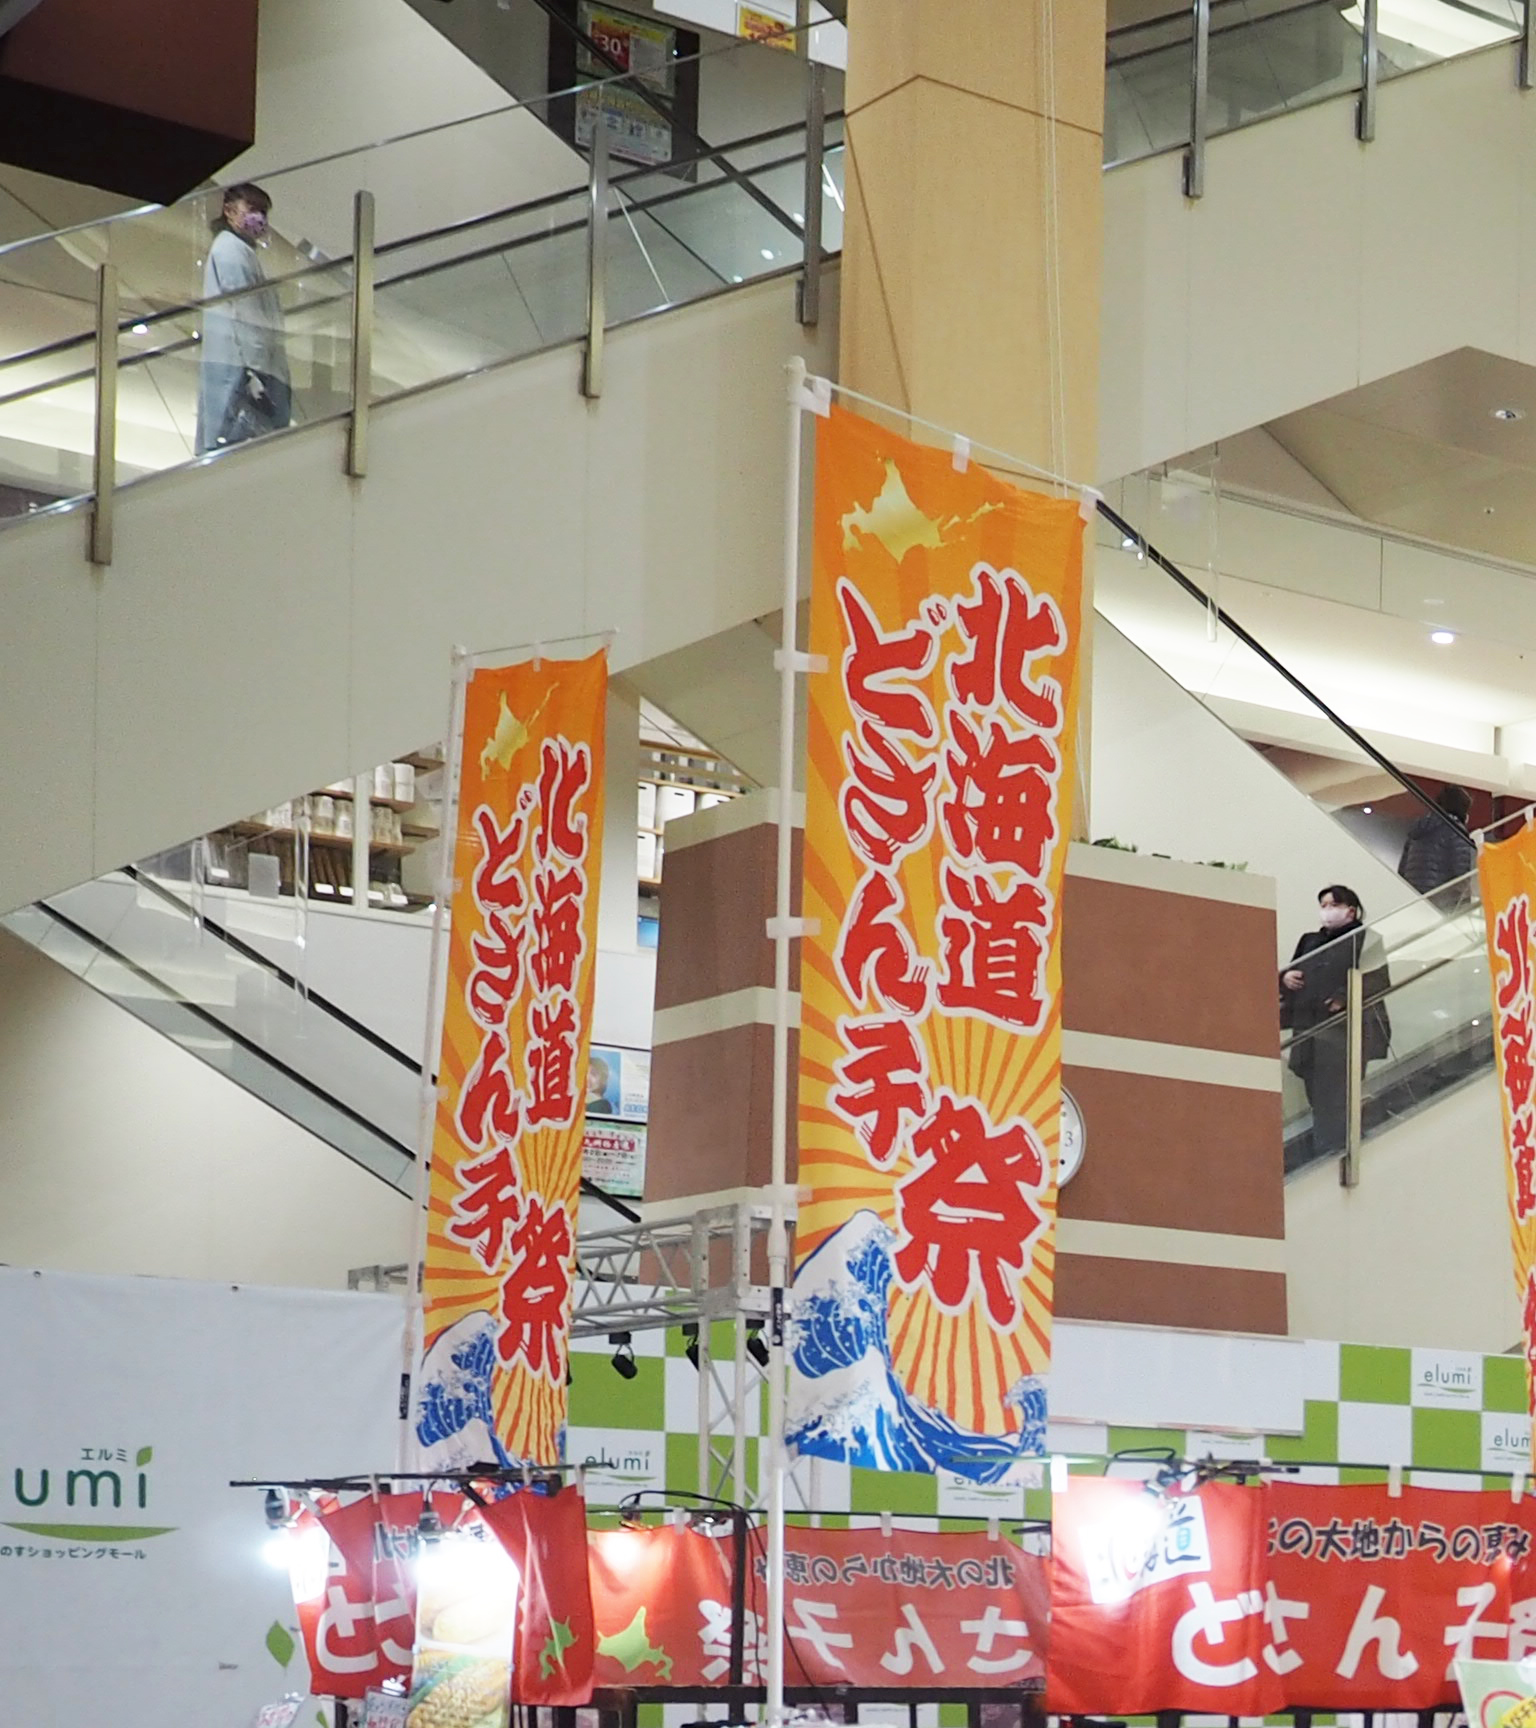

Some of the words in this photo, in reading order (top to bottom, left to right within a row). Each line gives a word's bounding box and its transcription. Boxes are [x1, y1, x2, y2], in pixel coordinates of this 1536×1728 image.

[940, 563, 1067, 1033] 北海道
[525, 734, 591, 1129] 北海道
[1496, 895, 1536, 1224] 北海道
[1424, 1364, 1471, 1385] elumi
[81, 1448, 128, 1462] エルミ
[15, 1467, 147, 1509] umi
[0, 1545, 147, 1560] のすショッピングモール
[1268, 1518, 1531, 1564] の大地からの恵み
